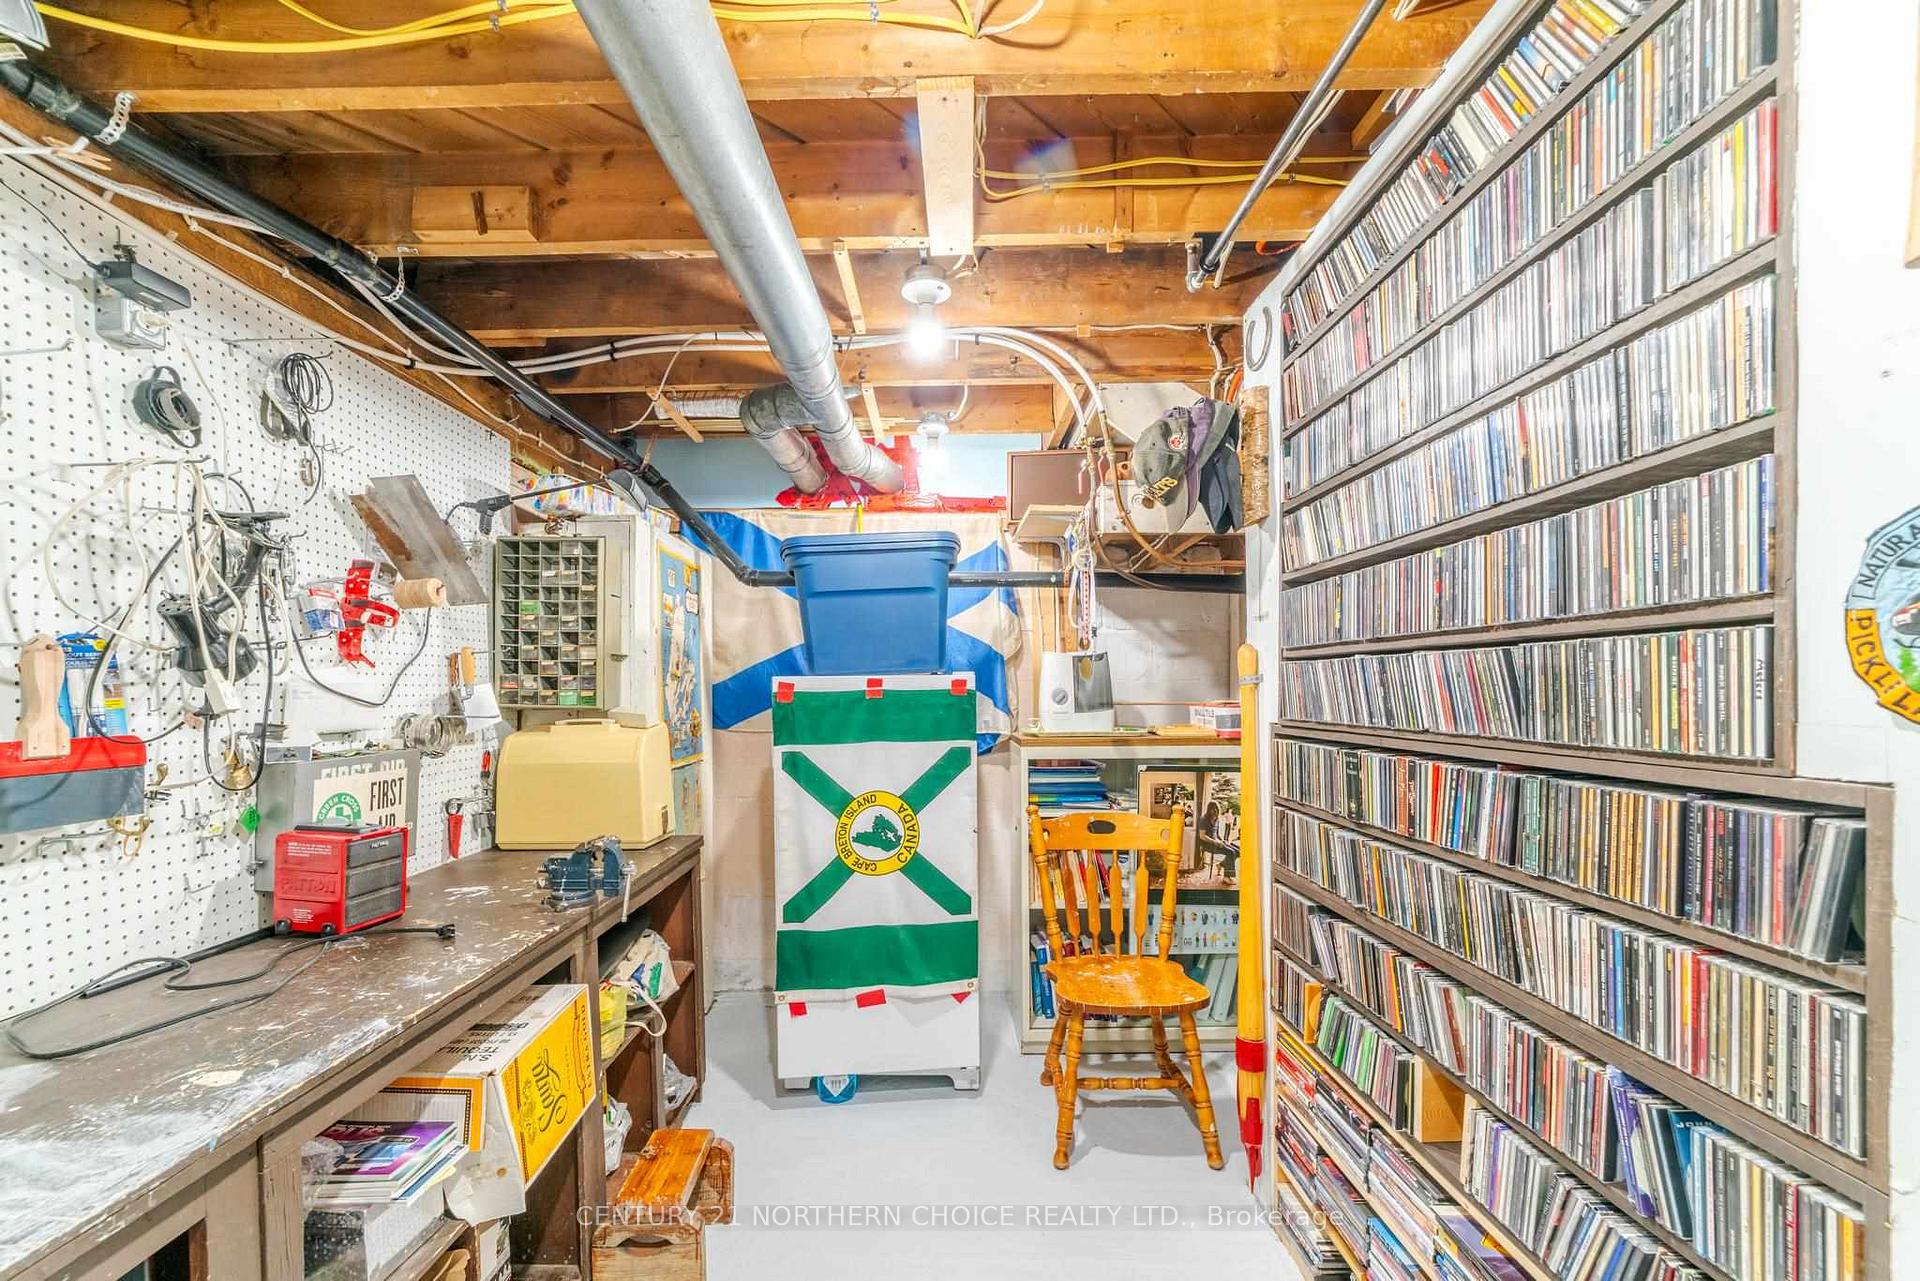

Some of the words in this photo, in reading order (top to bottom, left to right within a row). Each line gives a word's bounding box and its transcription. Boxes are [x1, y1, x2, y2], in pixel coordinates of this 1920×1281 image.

[369, 777, 405, 811] FIRST
[844, 794, 877, 820] ISLAND
[838, 822, 853, 860] BRETON
[896, 802, 918, 864] CANADA
[851, 857, 878, 872] CAPE
